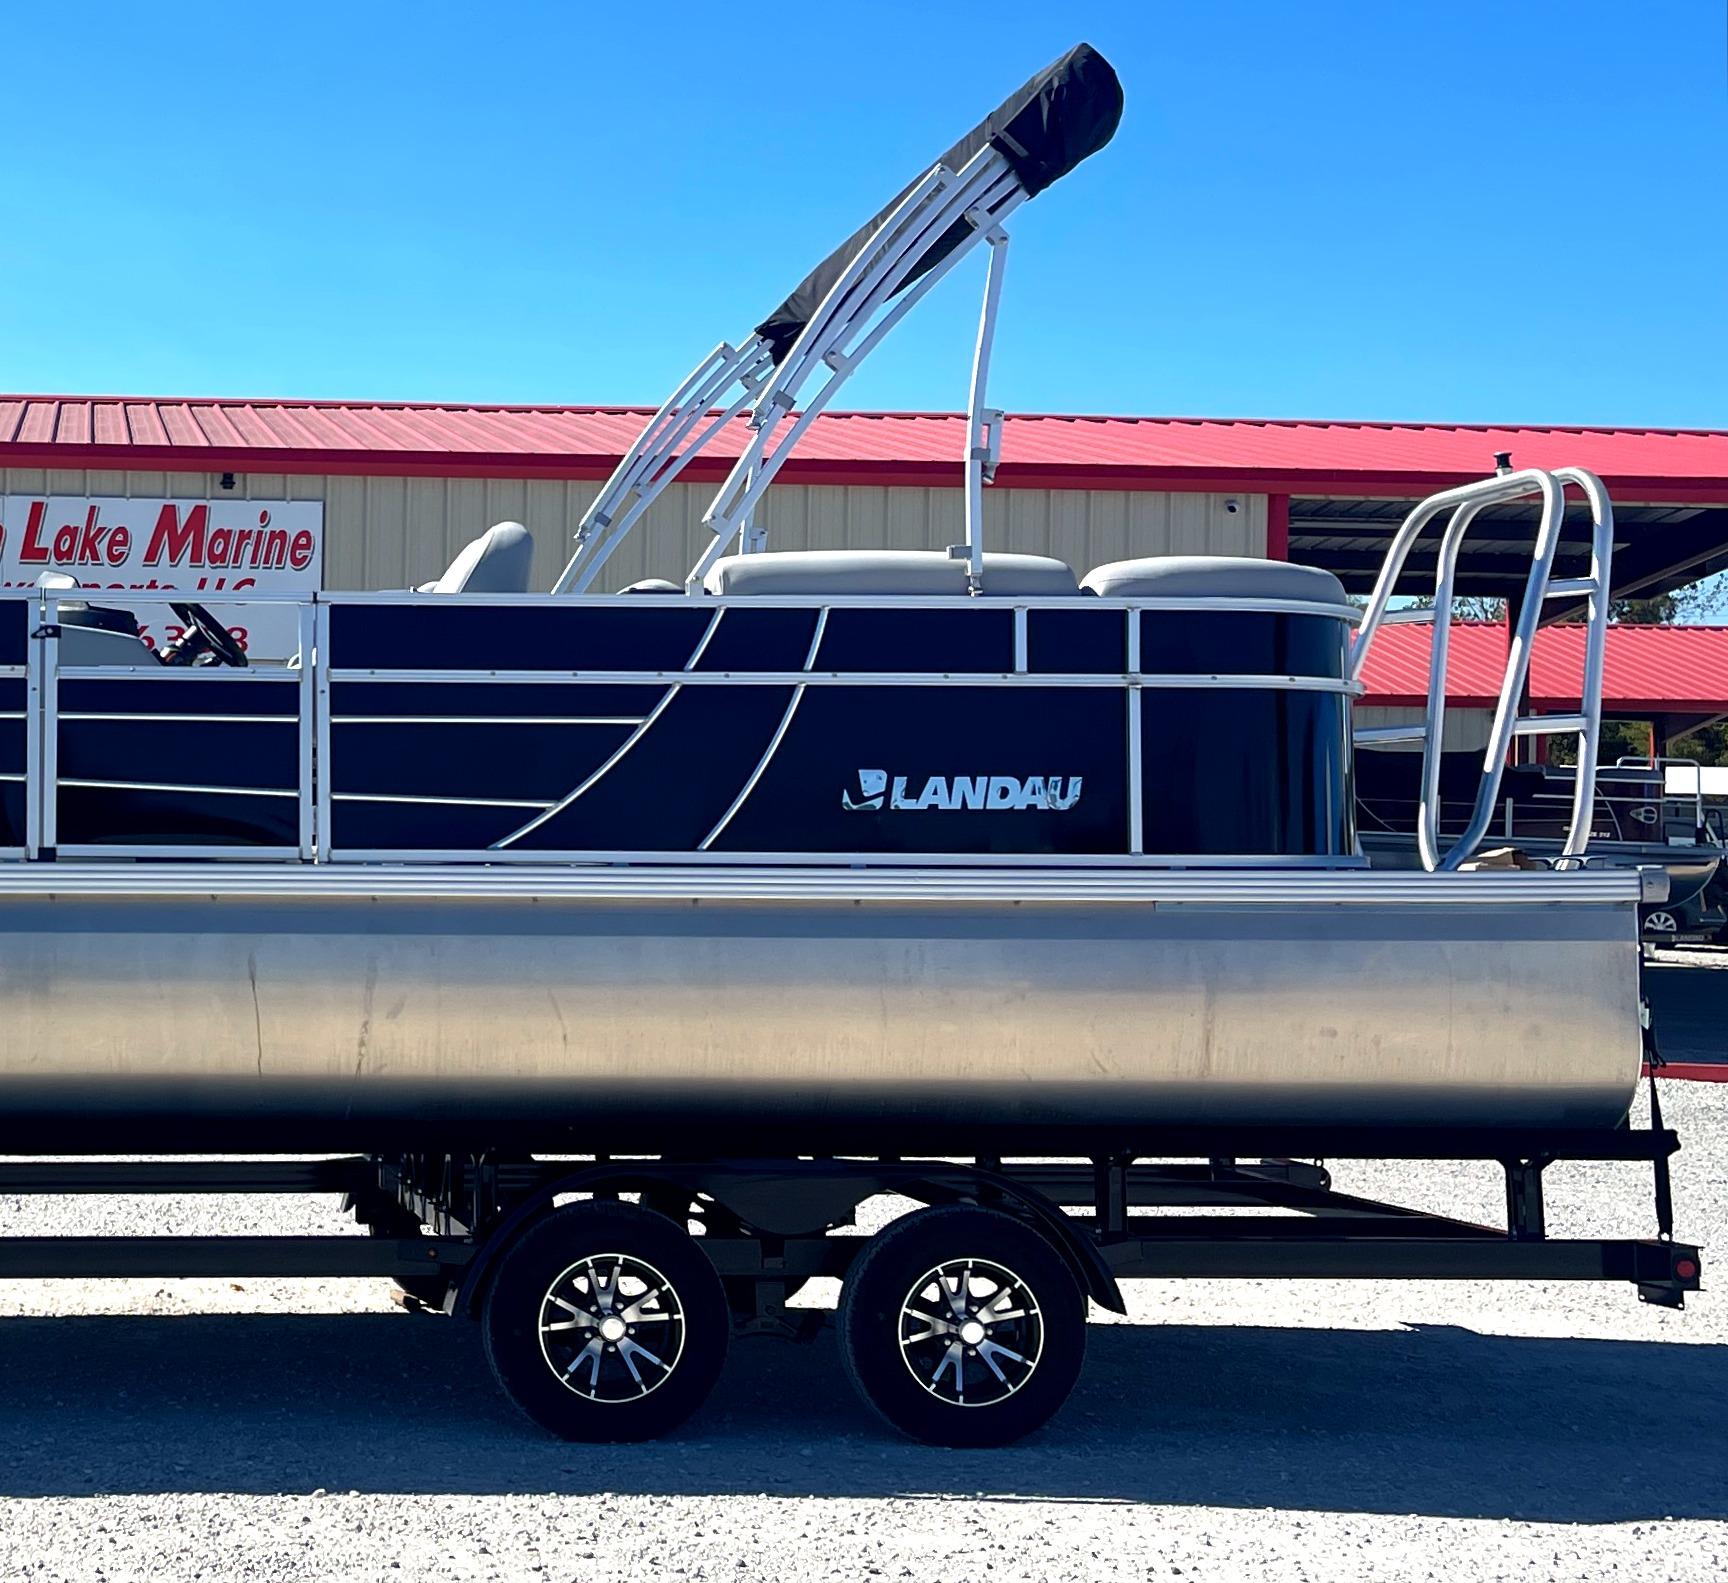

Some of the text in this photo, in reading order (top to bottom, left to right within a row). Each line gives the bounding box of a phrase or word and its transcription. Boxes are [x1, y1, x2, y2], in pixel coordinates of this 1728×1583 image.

[19, 501, 131, 566] Lake
[142, 504, 315, 570] Marine
[890, 776, 1083, 810] LANDAU
